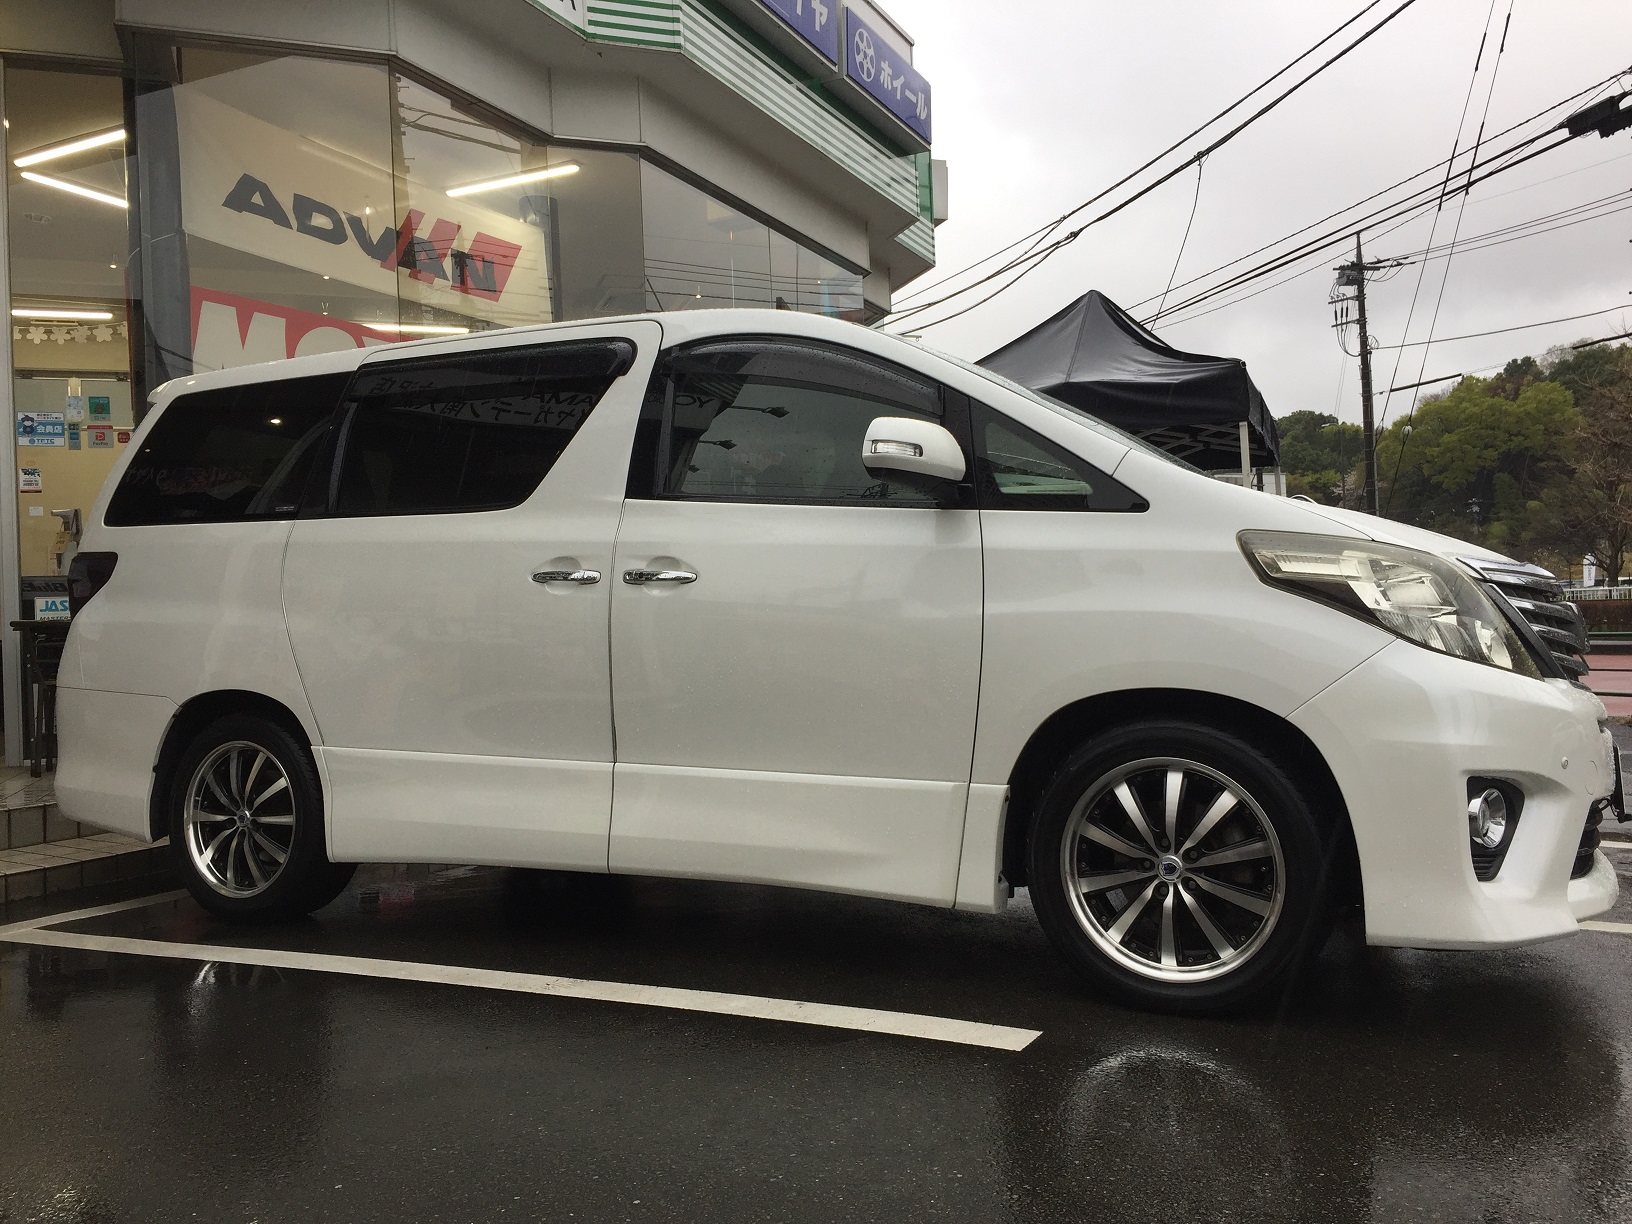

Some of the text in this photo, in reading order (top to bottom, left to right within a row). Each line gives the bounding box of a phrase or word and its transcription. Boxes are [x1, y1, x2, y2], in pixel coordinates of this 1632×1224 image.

[880, 60, 927, 120] ホイール
[222, 173, 498, 294] ADVAN
[36, 424, 63, 434] 会員店
